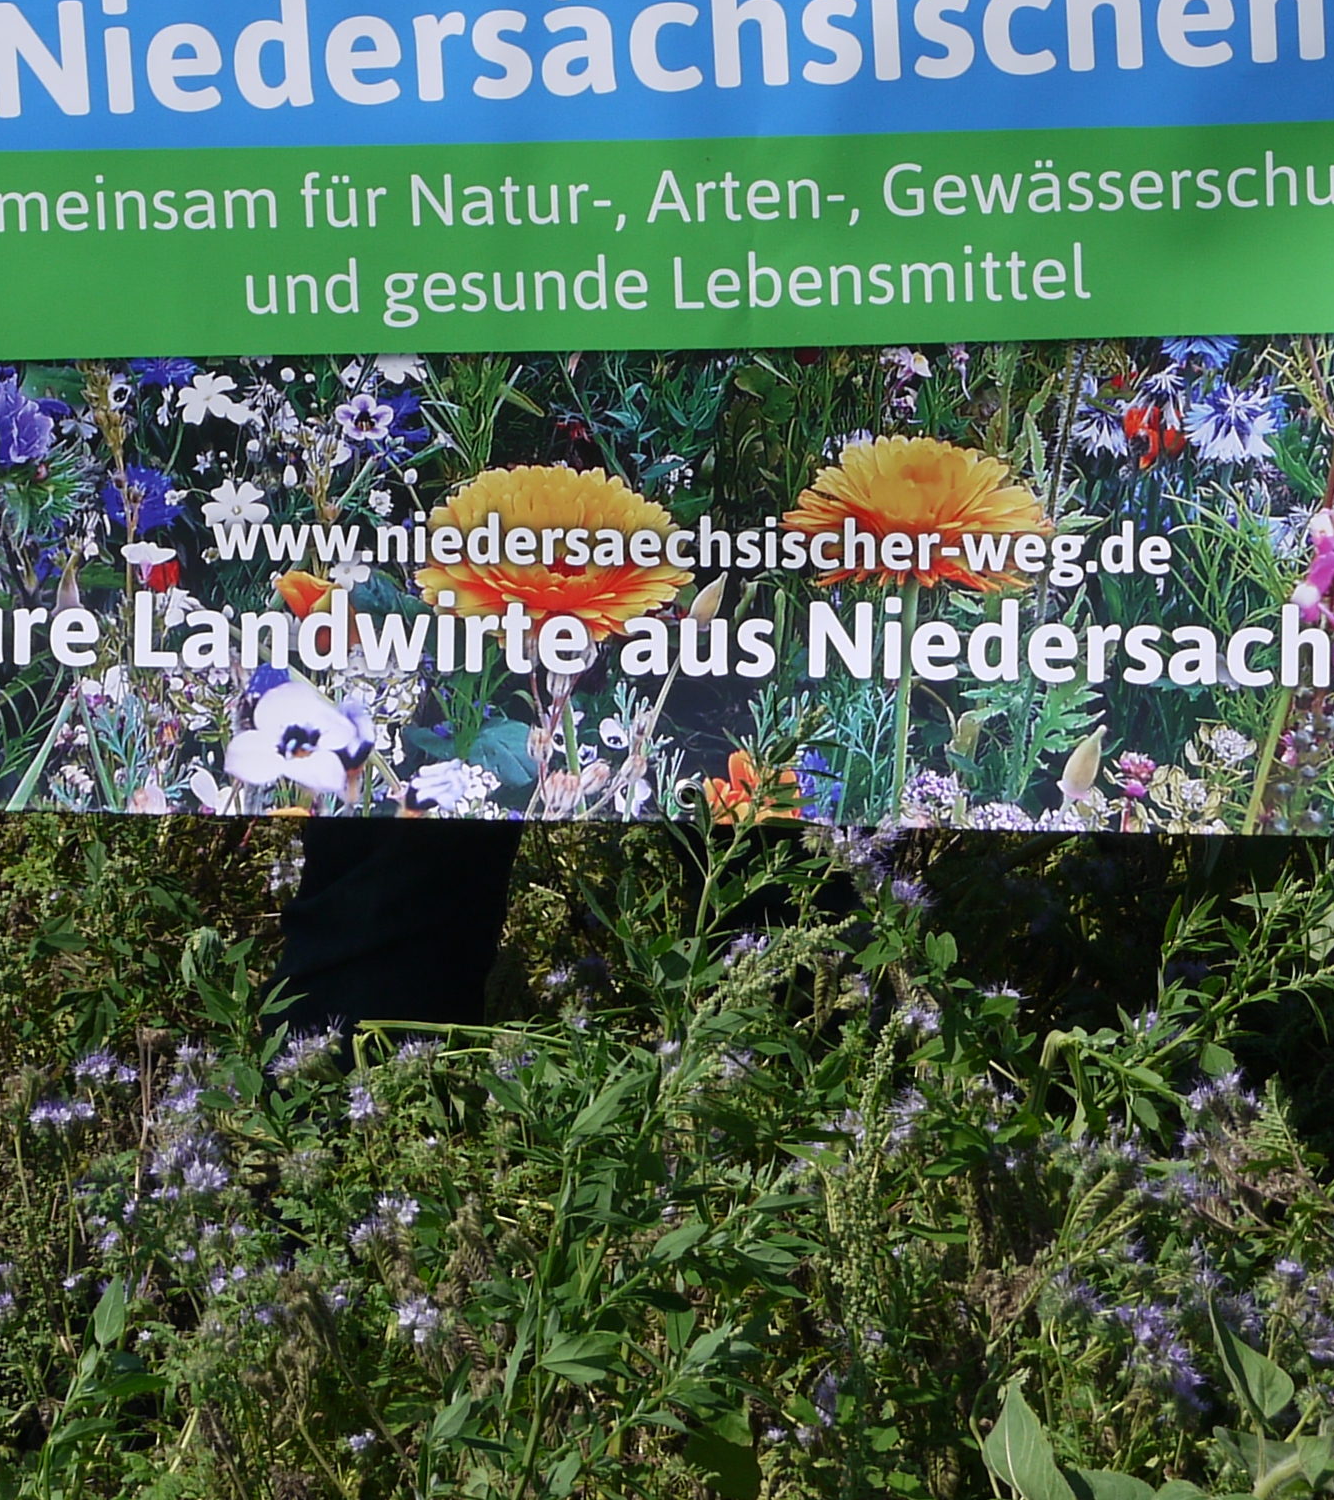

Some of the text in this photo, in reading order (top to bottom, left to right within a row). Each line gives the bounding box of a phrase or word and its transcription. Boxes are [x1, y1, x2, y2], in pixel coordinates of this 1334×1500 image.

[300, 171, 388, 229] für
[410, 172, 627, 233] Natur-,
[646, 168, 860, 227] Arten-,
[244, 241, 1092, 328] und gesunde Lebensmittel
[213, 513, 1172, 586] www.niedersaechsischer-weg.de
[133, 589, 589, 676] Landwirte
[620, 610, 777, 679] aus
